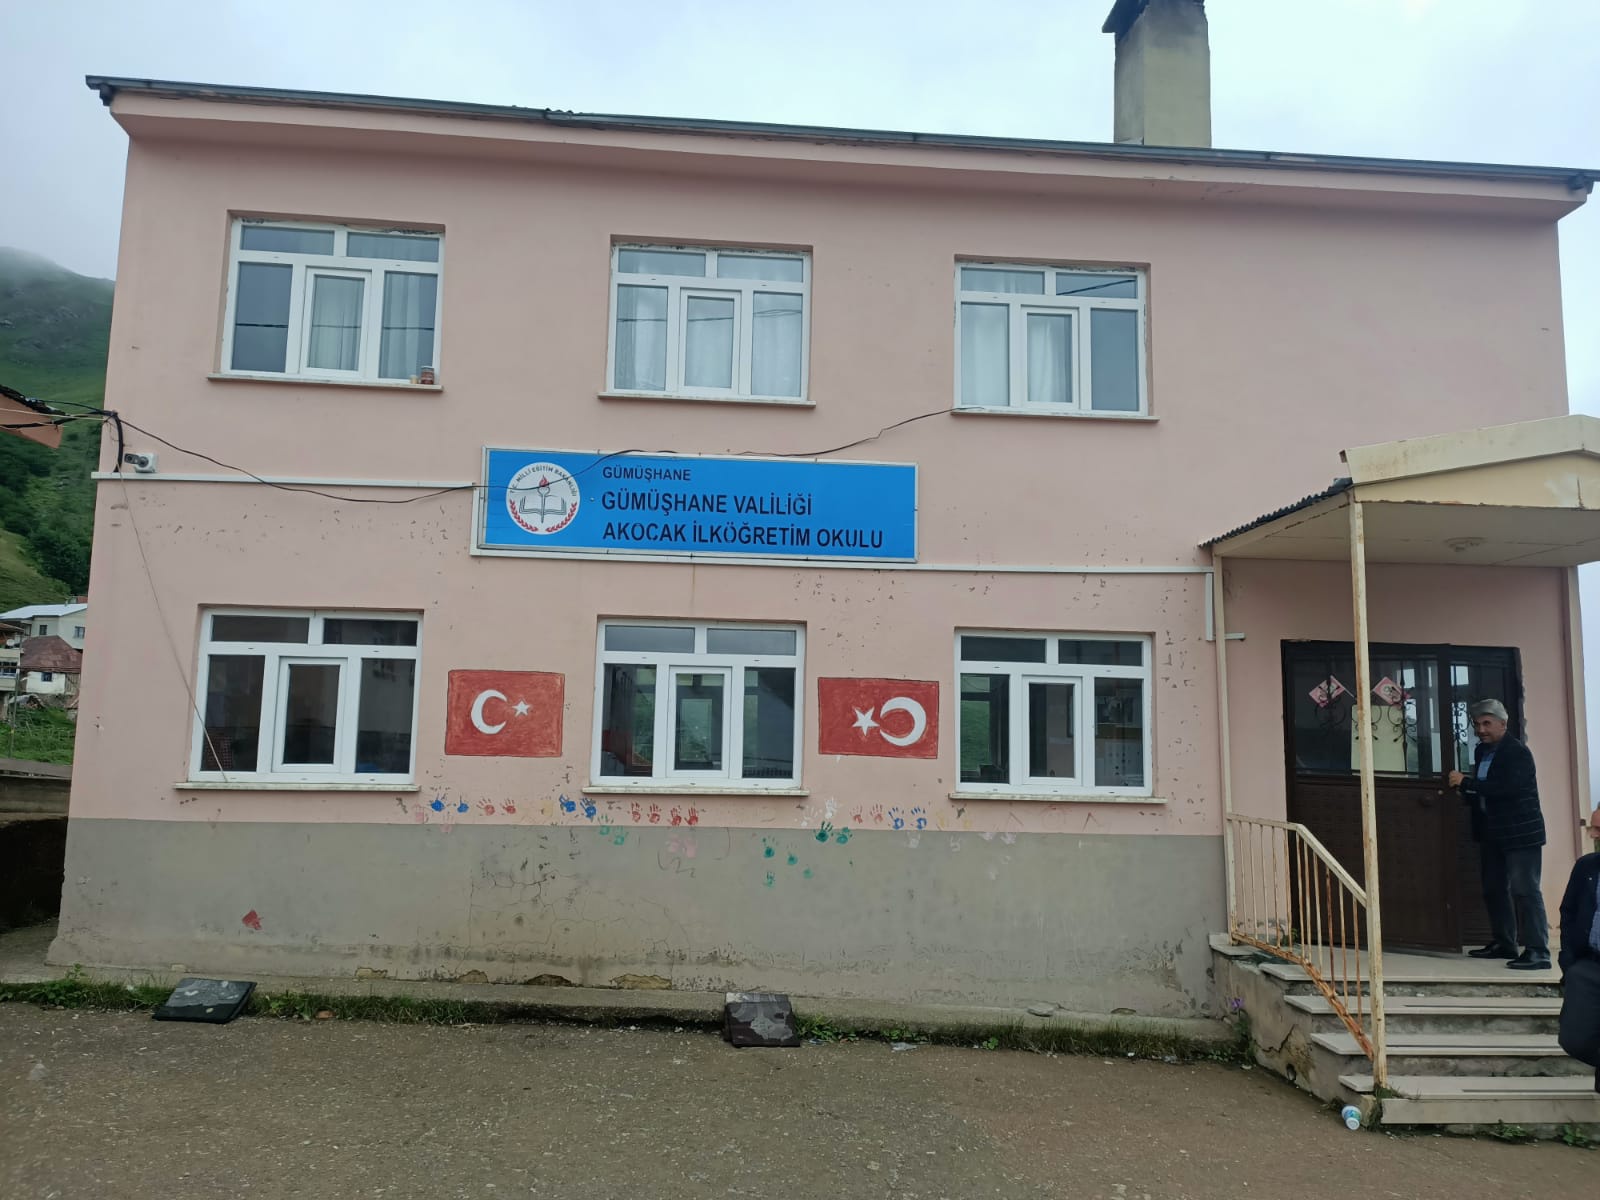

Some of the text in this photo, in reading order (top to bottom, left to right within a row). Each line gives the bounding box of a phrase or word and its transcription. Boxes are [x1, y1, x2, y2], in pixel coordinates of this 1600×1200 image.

[602, 465, 691, 482] GÜMÜŞHANE
[602, 487, 812, 516] GÜMÜŞHANE VALİLİĞİ
[602, 520, 883, 549] AKOCAK İLKÖĞRETİM OKULU
